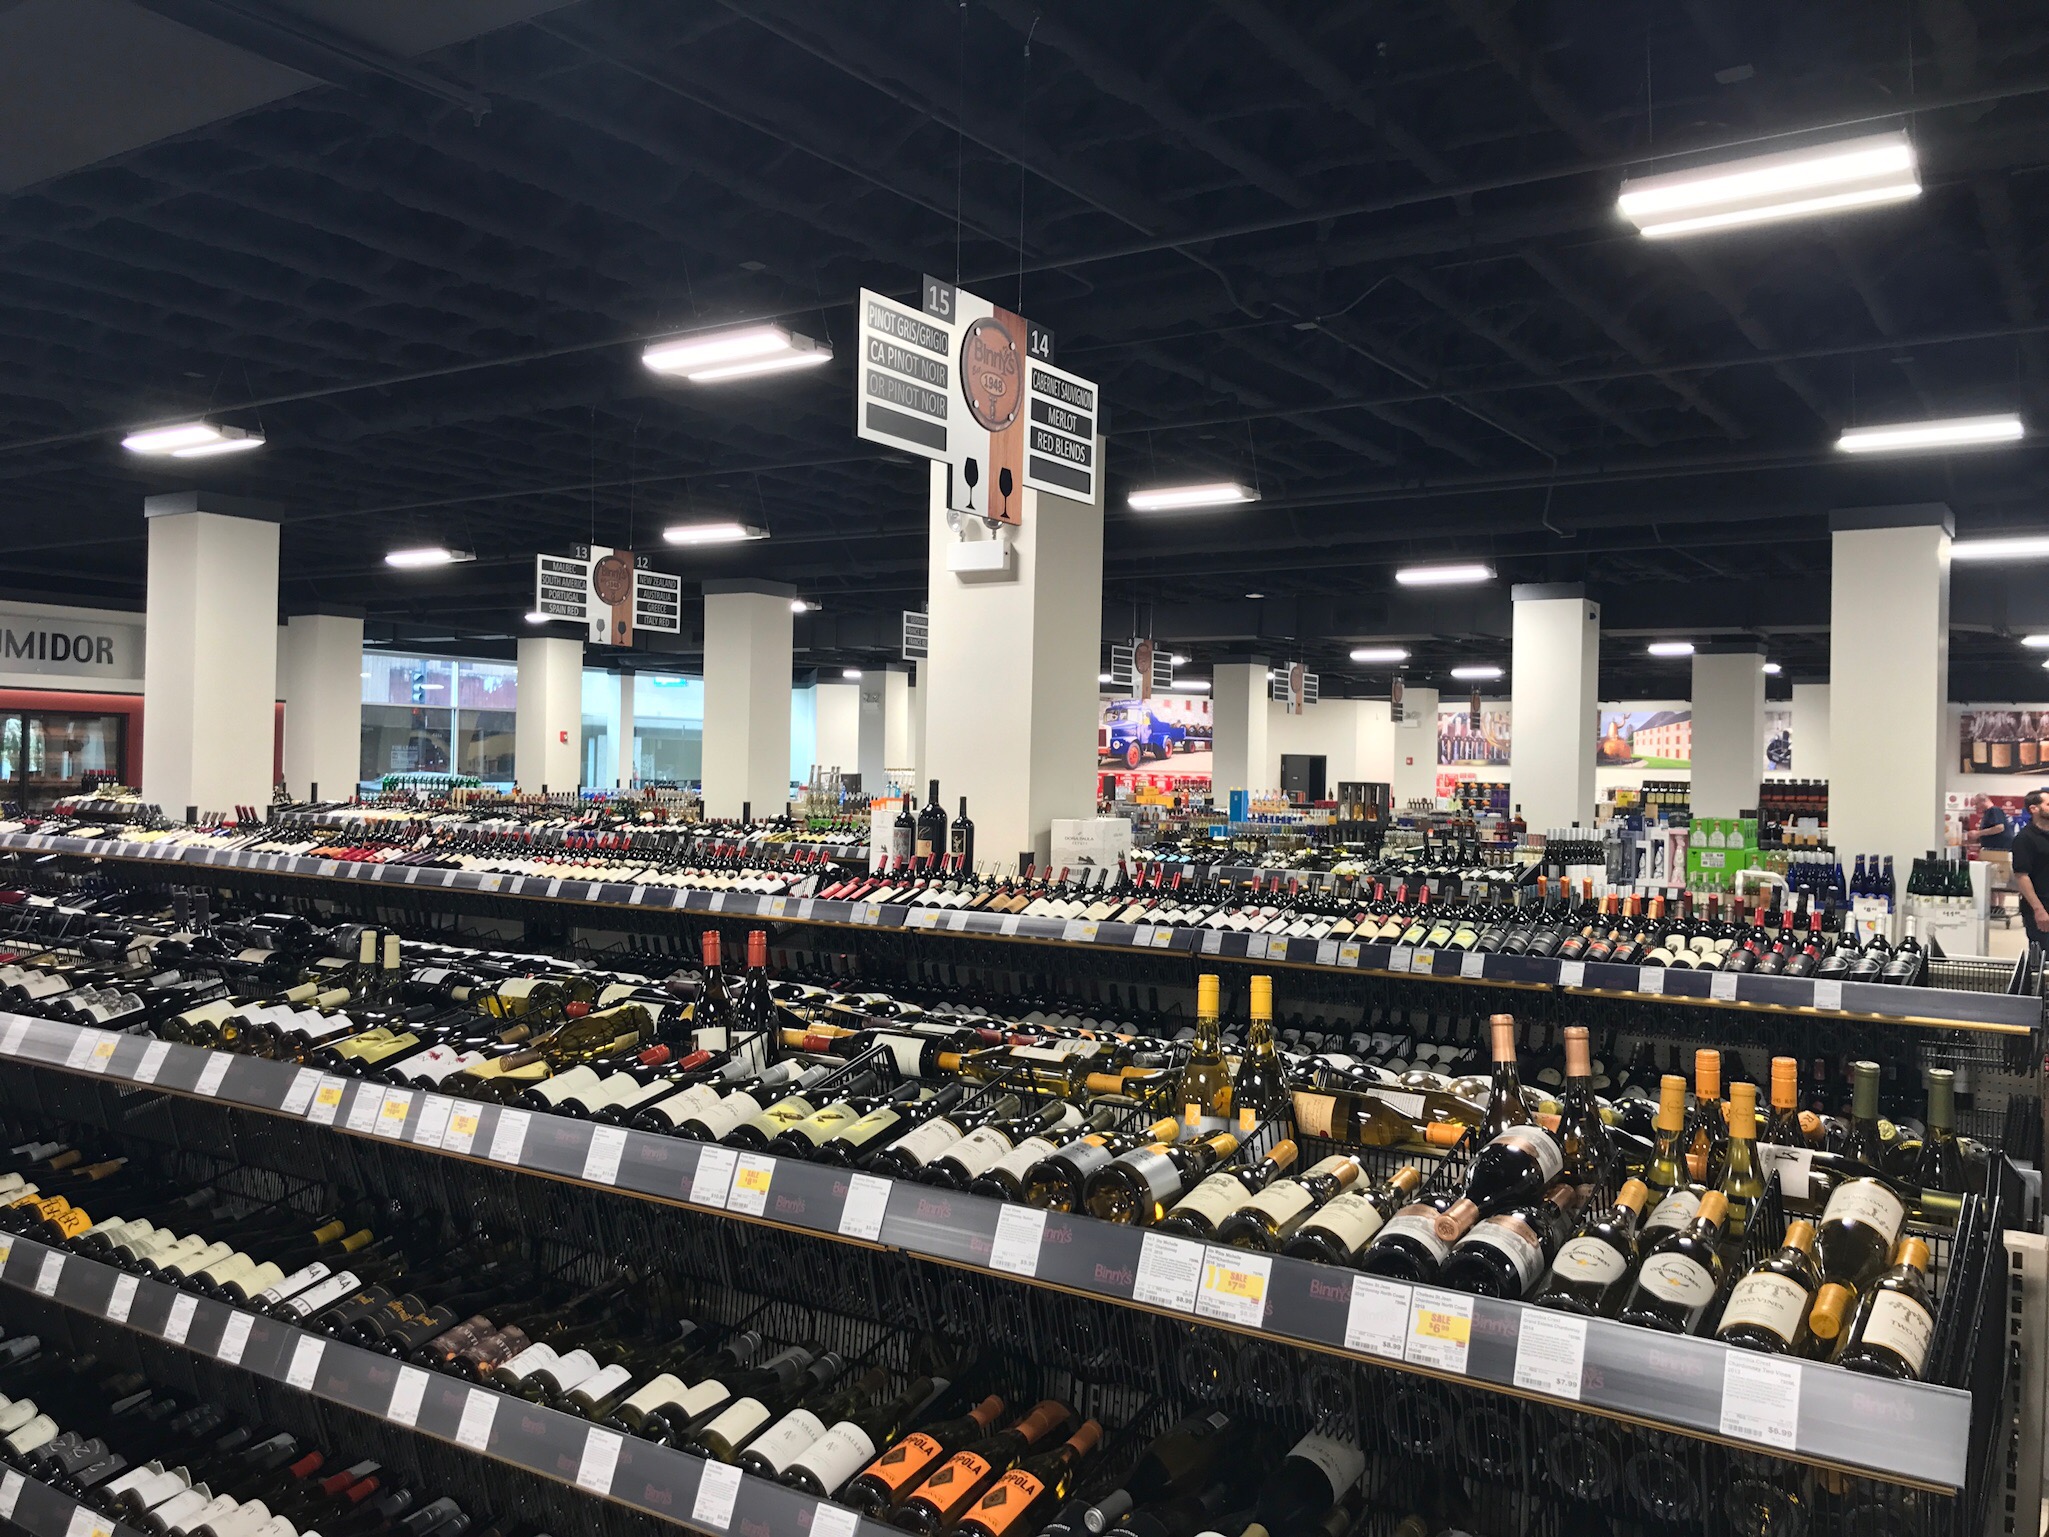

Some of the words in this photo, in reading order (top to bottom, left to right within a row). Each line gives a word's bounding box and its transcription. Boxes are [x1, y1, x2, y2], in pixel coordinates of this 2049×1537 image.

[929, 285, 950, 316] 15
[869, 304, 896, 333] PINOT
[897, 317, 948, 353] GRIS/GRIGIO
[1031, 330, 1050, 358] 14
[870, 341, 885, 363] CA
[887, 346, 919, 375] PINOT
[921, 359, 946, 385] NOIR
[984, 375, 1003, 393] 1948
[1032, 370, 1061, 397] CABERNET
[1061, 384, 1093, 410] SAUVIGNON
[869, 374, 885, 396] OR
[888, 380, 919, 407] PINOT
[921, 391, 946, 417] NOIR
[1048, 406, 1078, 433] MERLOT
[1037, 431, 1054, 452] RED
[1055, 438, 1086, 463] BLENDS
[575, 546, 588, 559] 13
[552, 562, 577, 574] MALBEC
[637, 556, 649, 569] 12
[542, 575, 561, 585] SOUTH
[561, 578, 586, 589] AMERICA
[639, 575, 653, 585] NEW
[652, 577, 677, 589] ZEALAND
[548, 589, 580, 603] PORTUGAL
[643, 590, 672, 601] AUSTRALIA
[548, 604, 566, 615] SPAIN
[566, 606, 579, 616] RED
[646, 602, 667, 614] GREECE
[643, 616, 659, 625] ITALY
[659, 617, 670, 627] RED
[1094, 1264, 1133, 1286] Binny's
[1229, 1272, 1248, 1283] SALE
[1756, 1298, 1785, 1311] VINES
[1431, 1313, 1451, 1325] SALE
[1556, 1378, 1578, 1388] $7.99
[843, 1431, 865, 1457] VALLEY
